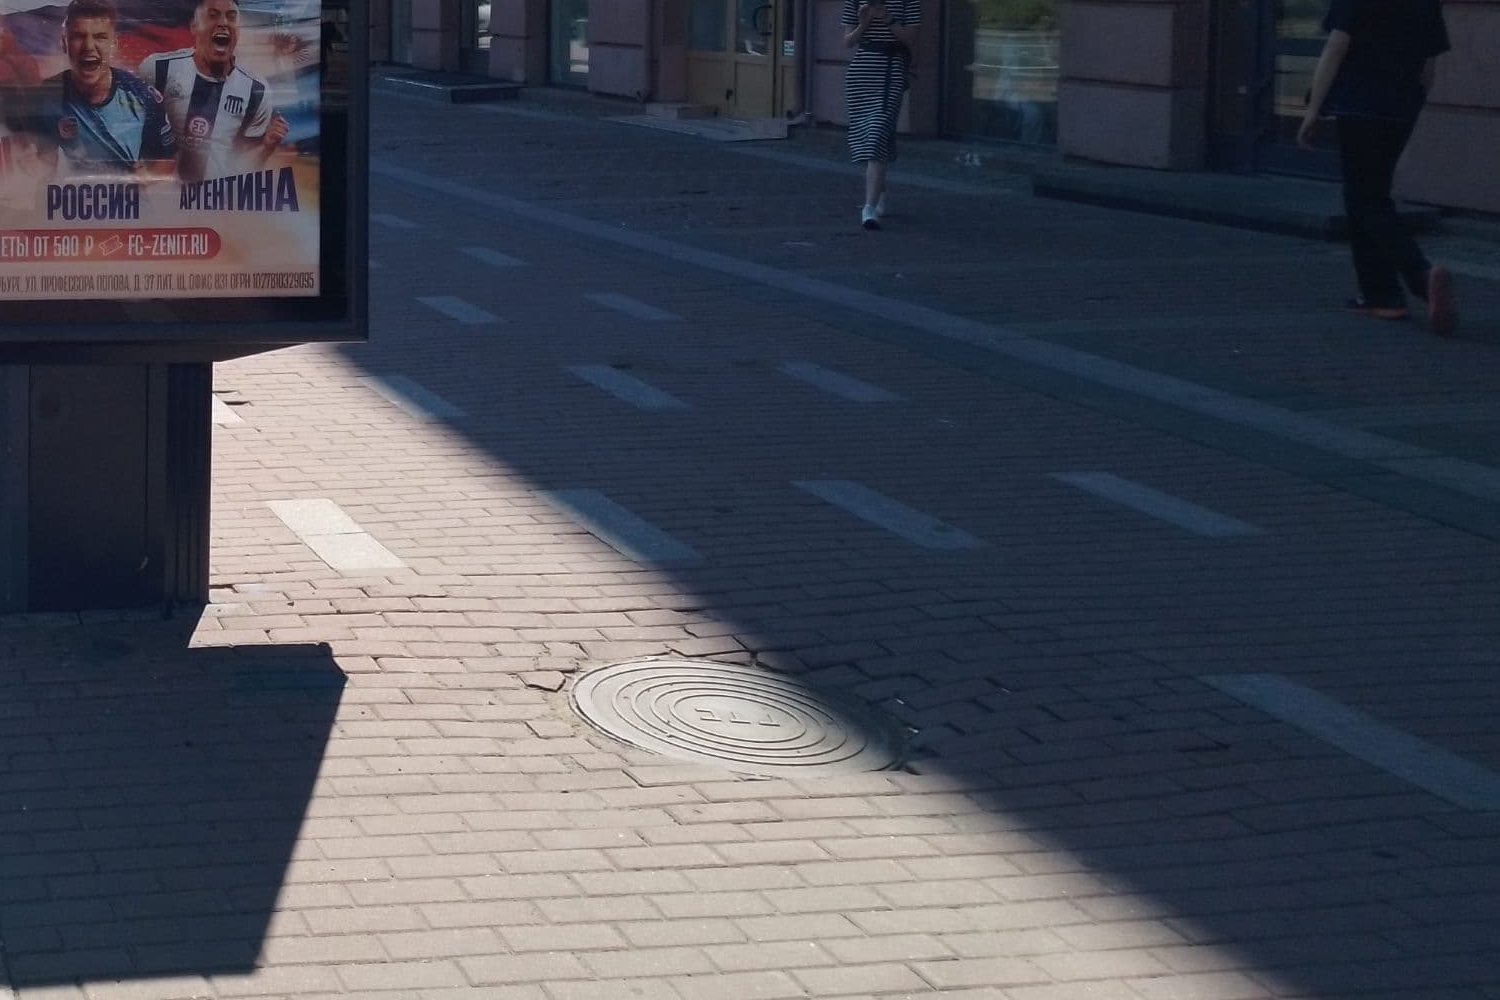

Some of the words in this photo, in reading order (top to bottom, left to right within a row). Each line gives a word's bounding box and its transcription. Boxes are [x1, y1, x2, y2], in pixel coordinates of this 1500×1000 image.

[47, 183, 140, 221] РОССИЯ
[180, 167, 299, 213] АРГЕНТИНА
[34, 236, 50, 257] ОТ
[53, 235, 79, 257] 500
[128, 234, 208, 256] FC-ZENIT.RU
[41, 274, 95, 293] ПРОФЕССОРА
[189, 273, 213, 290] ОФИС
